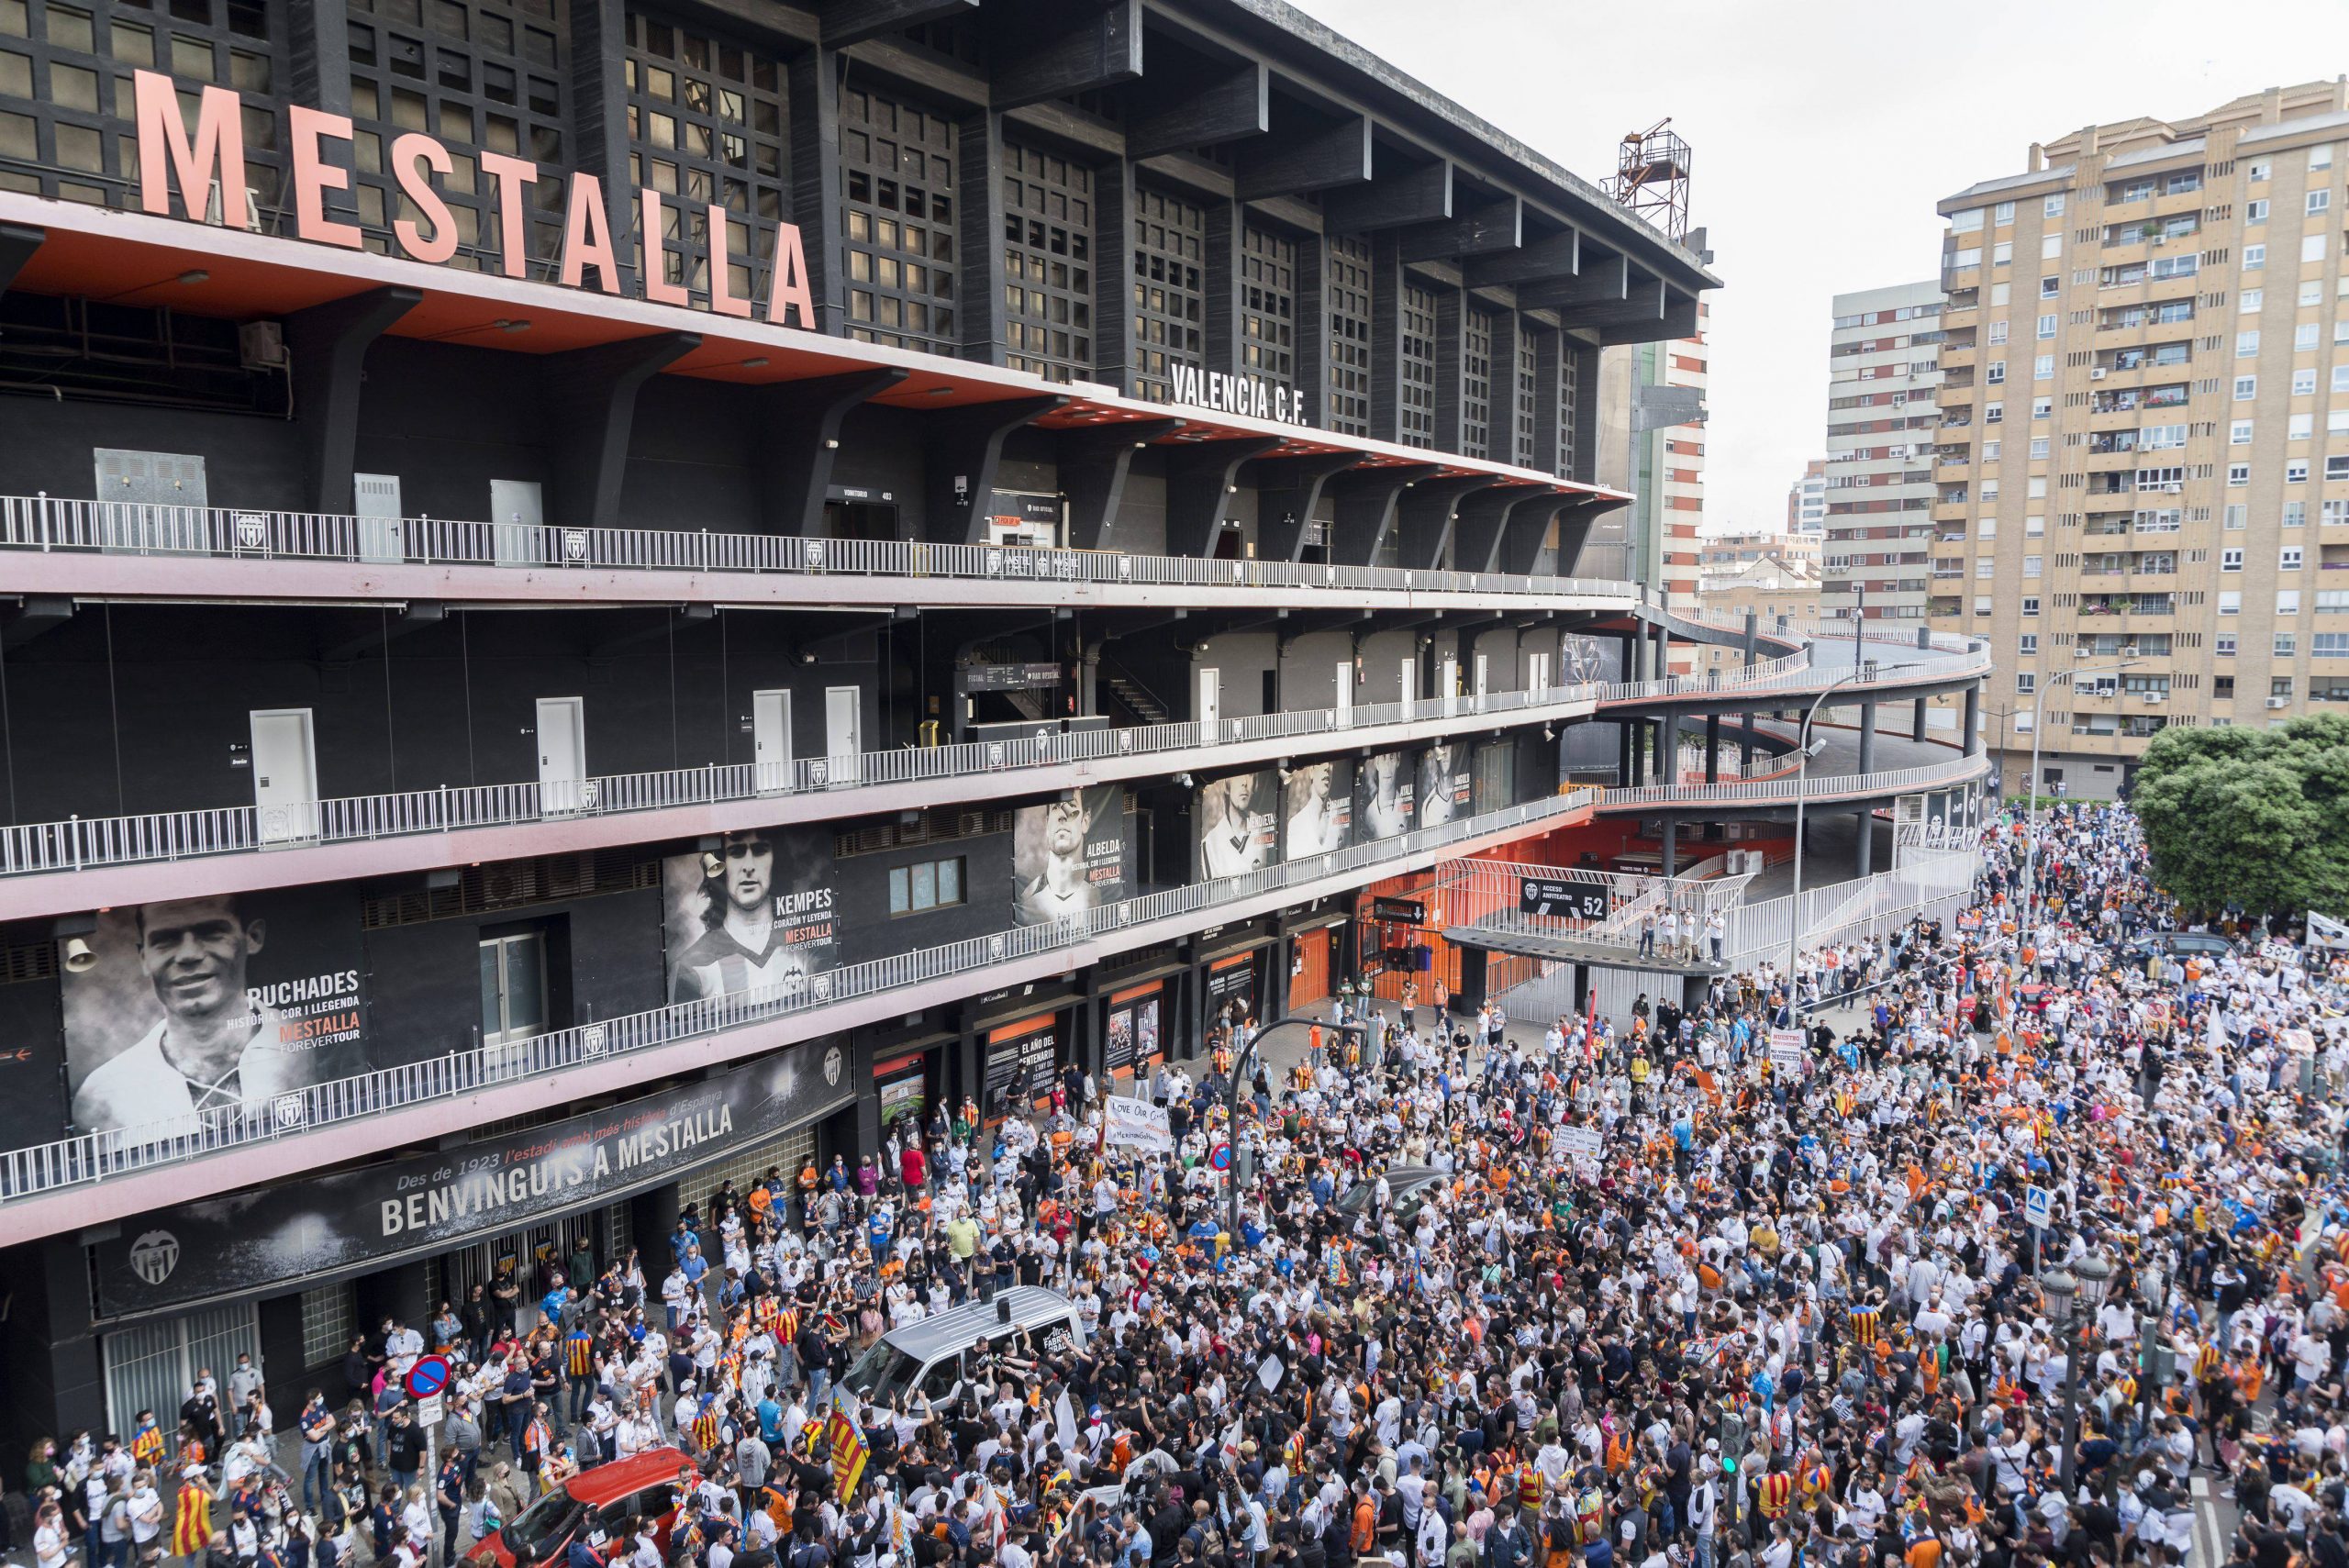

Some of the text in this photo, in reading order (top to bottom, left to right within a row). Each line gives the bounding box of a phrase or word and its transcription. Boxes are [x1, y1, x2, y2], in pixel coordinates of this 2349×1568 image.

[133, 69, 816, 330] MESTALLA
[1171, 363, 1308, 426] VALENCIA C.F.
[882, 492, 892, 501] 403
[1086, 839, 1119, 858] ALBELDA
[1089, 865, 1120, 882] MESTALLA
[1542, 884, 1563, 893] ACCESO
[1542, 893, 1573, 901] ANFITEATRO
[776, 888, 832, 917] KEMPES
[1583, 896, 1604, 917] 52
[774, 916, 801, 929] CORAZÓN
[802, 915, 807, 924] Y
[807, 910, 832, 923] LEYENDA
[785, 923, 832, 944] MESTALLA
[247, 970, 359, 1010] PUCHADES
[281, 1006, 303, 1020] COR
[305, 1005, 309, 1016] I
[312, 995, 360, 1015] LLEGENDA
[279, 1011, 360, 1043] MESTALLA
[1022, 1035, 1054, 1054] EL AÑO DEL
[1019, 1048, 1054, 1067] CENTENARIO
[1032, 1068, 1054, 1082] CENTENARI
[1112, 1102, 1130, 1114] LOVE
[396, 1089, 723, 1192] Des de 1923 l'estadi amb més història d'Espanya
[382, 1103, 733, 1237] BENVINGUTS A MESTALLA
[1043, 1331, 1073, 1350] FABRCA
